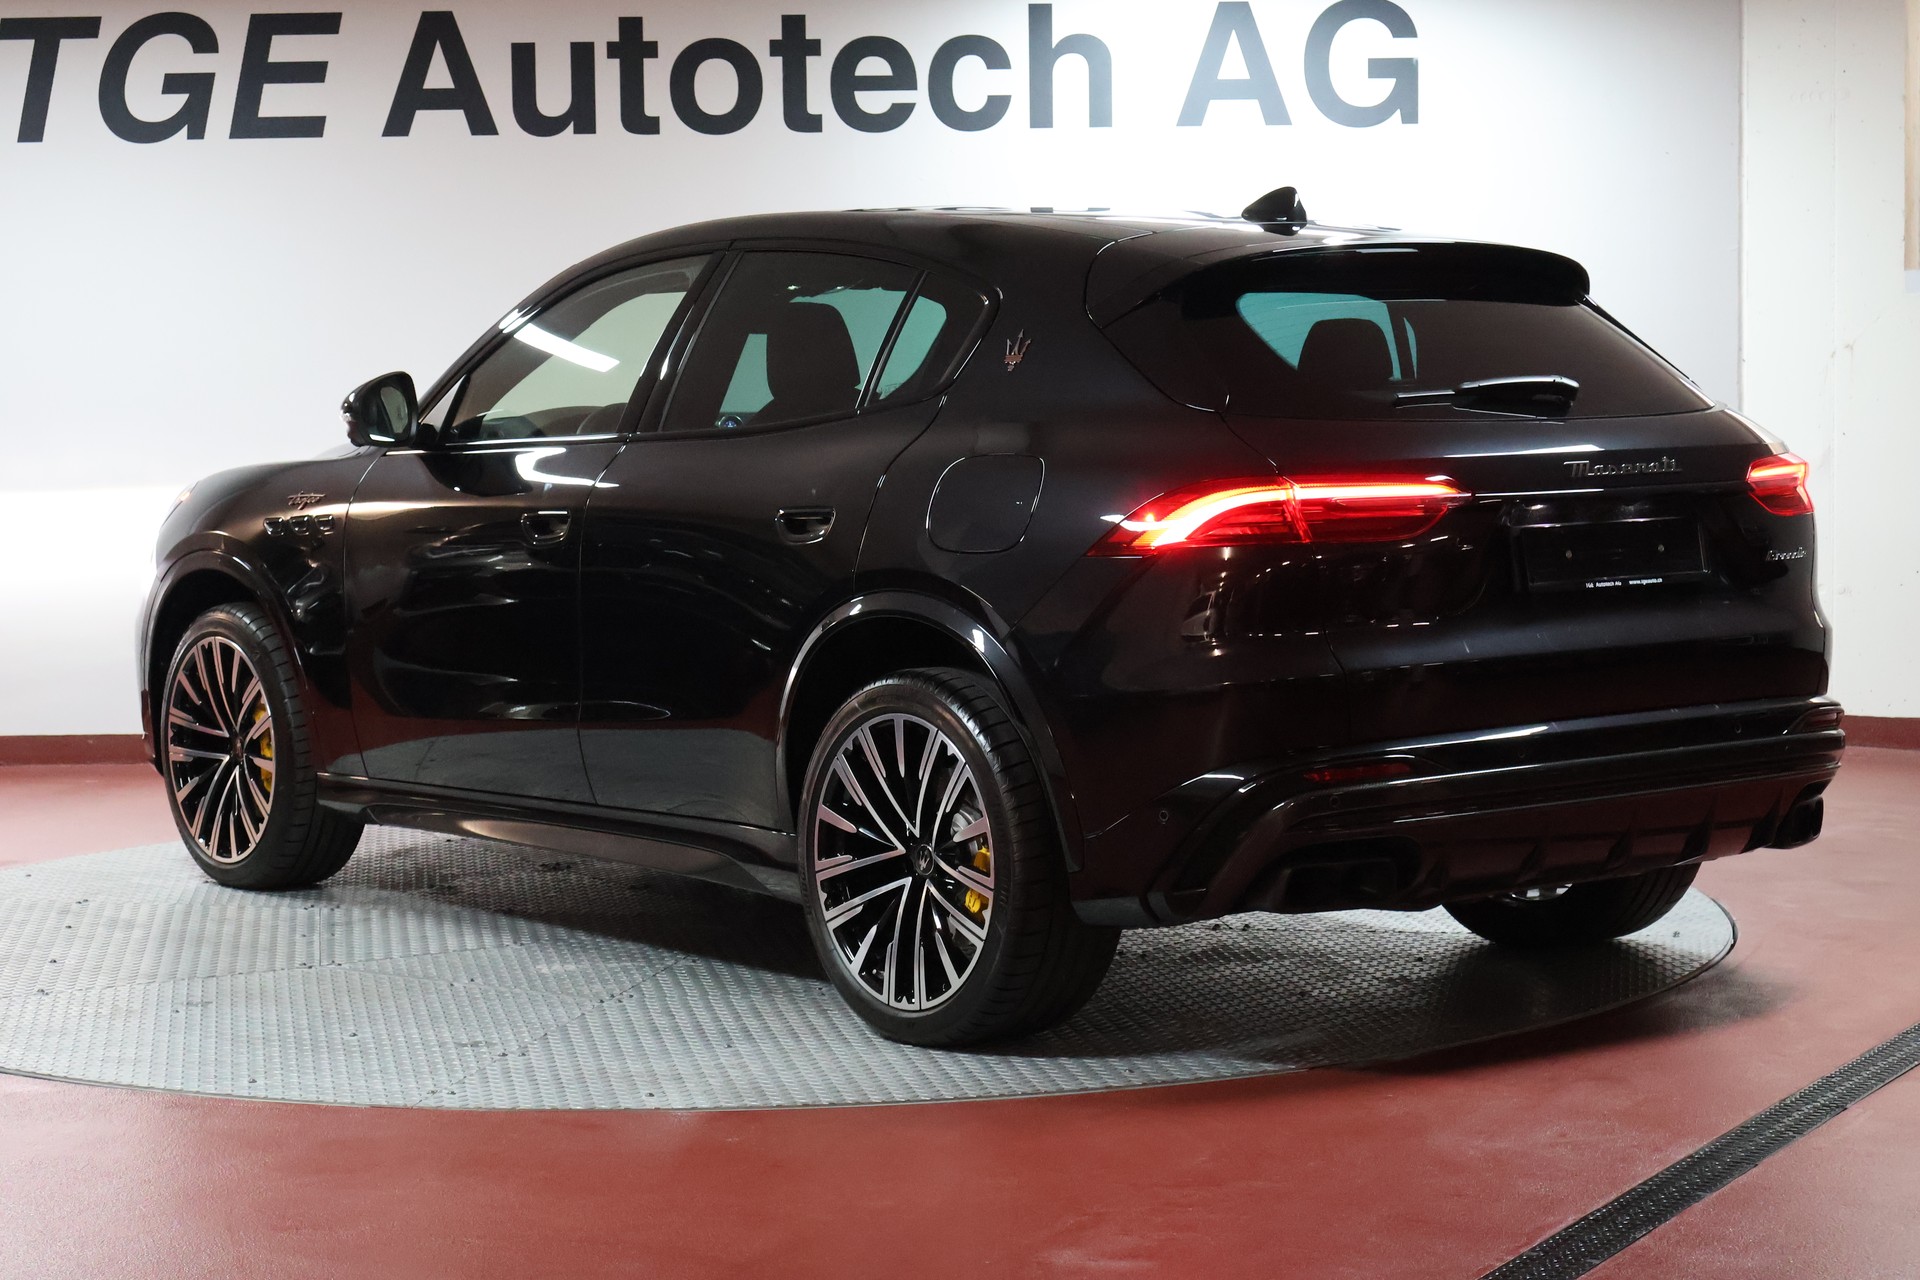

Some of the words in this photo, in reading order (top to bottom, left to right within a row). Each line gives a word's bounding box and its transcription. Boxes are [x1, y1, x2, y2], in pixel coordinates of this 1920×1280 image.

[381, 3, 1112, 137] Autotech
[1176, 0, 1419, 128] AG
[1563, 456, 1681, 478] Maserati
